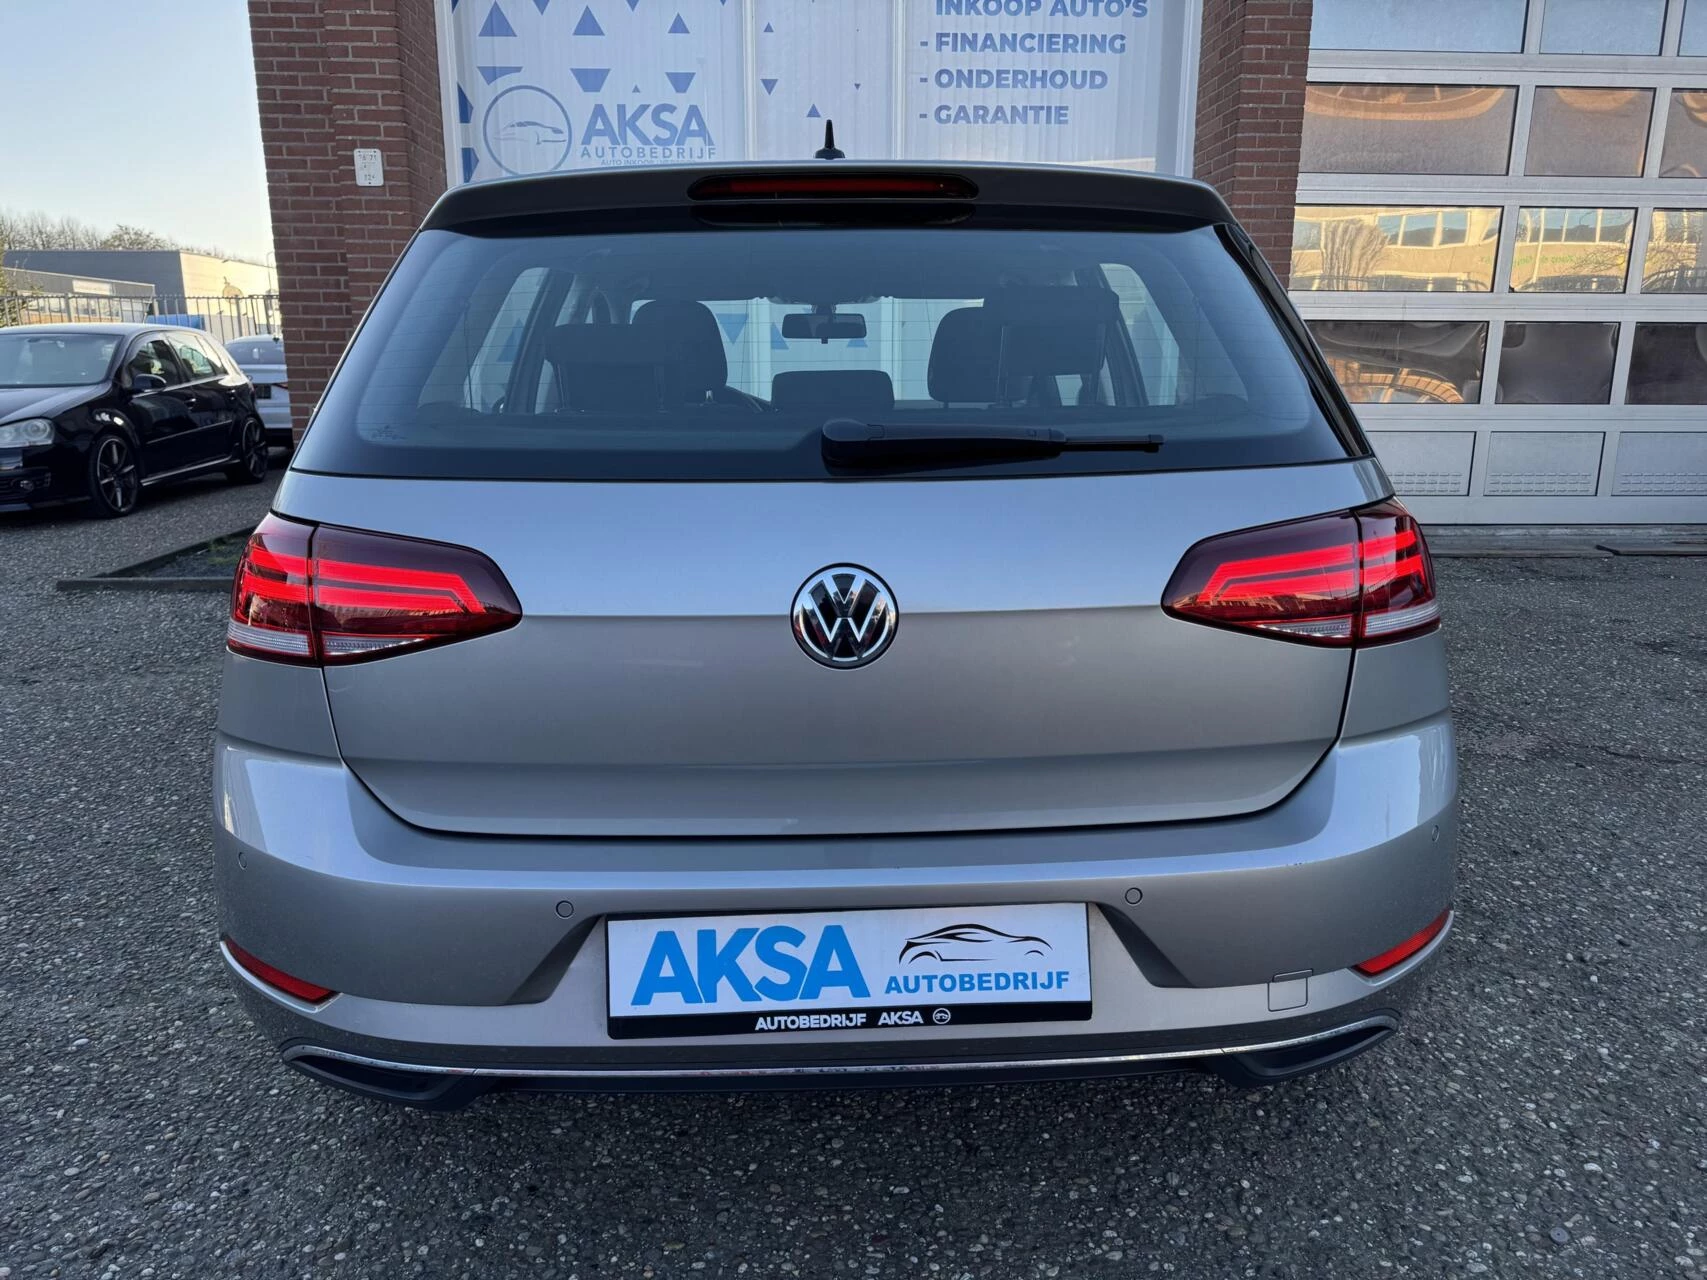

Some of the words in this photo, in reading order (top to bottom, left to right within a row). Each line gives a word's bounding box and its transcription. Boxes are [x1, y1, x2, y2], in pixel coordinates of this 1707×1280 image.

[935, 0, 1042, 16] INKOOP
[1049, 0, 1148, 17] AUTO'S
[935, 32, 1126, 54] FINANCIERING
[934, 69, 1108, 90] ONDERHOUD
[581, 103, 715, 147] AKSA
[934, 105, 1069, 125] GARANTIE
[581, 146, 716, 159] AUTOBEDRIJF
[630, 925, 871, 1006] AKSA
[884, 971, 1070, 994] AUTOBEDRIJF
[755, 1013, 867, 1031] AUTOBEDRIJF
[878, 1011, 924, 1026] AKSA
